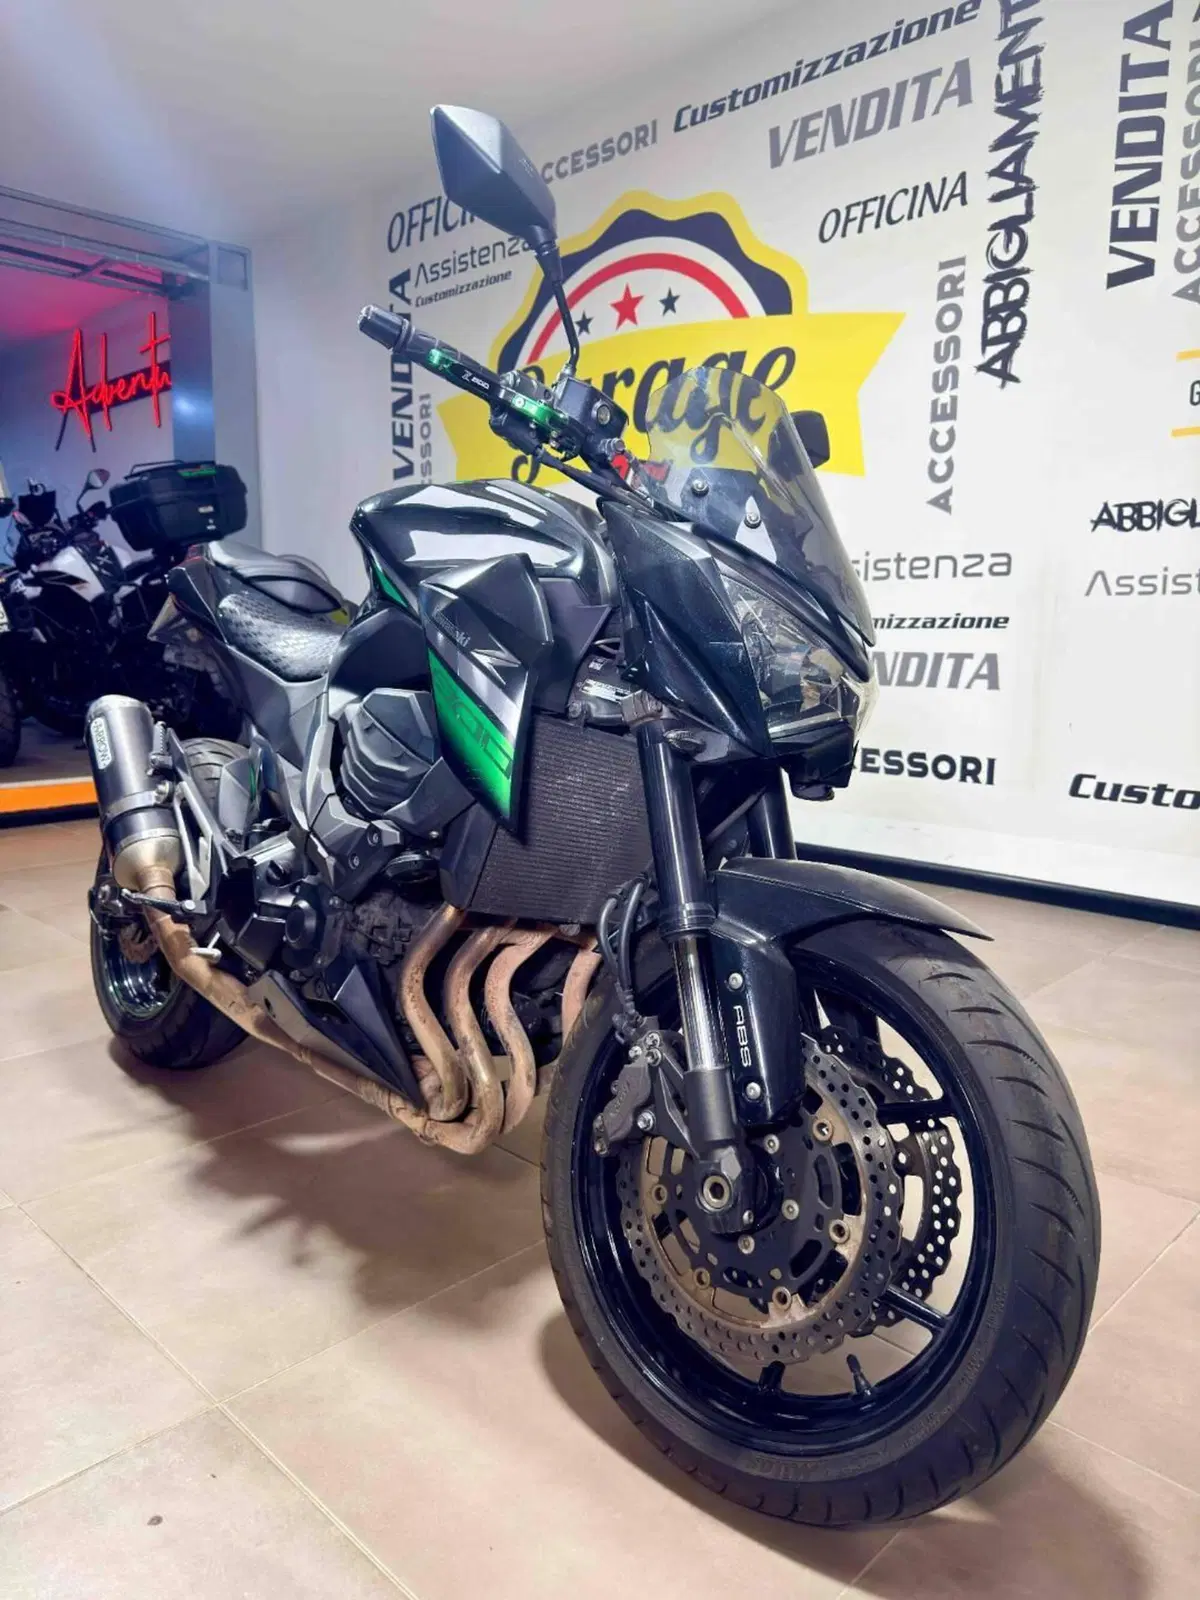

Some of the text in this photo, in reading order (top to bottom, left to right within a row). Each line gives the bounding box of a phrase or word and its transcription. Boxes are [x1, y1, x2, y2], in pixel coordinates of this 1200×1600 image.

[673, 0, 982, 133] Customizzazione
[768, 57, 973, 169] VENDITA
[1106, 0, 1174, 290] VENDITA
[541, 119, 658, 184] CCESSORI
[818, 171, 968, 244] OFFICINA
[415, 271, 512, 308] Customizzazione
[926, 254, 966, 515] ACCESSORI
[853, 747, 996, 786] ESSORI
[1069, 773, 1200, 810] Custo
[733, 1005, 752, 1068] ABS
